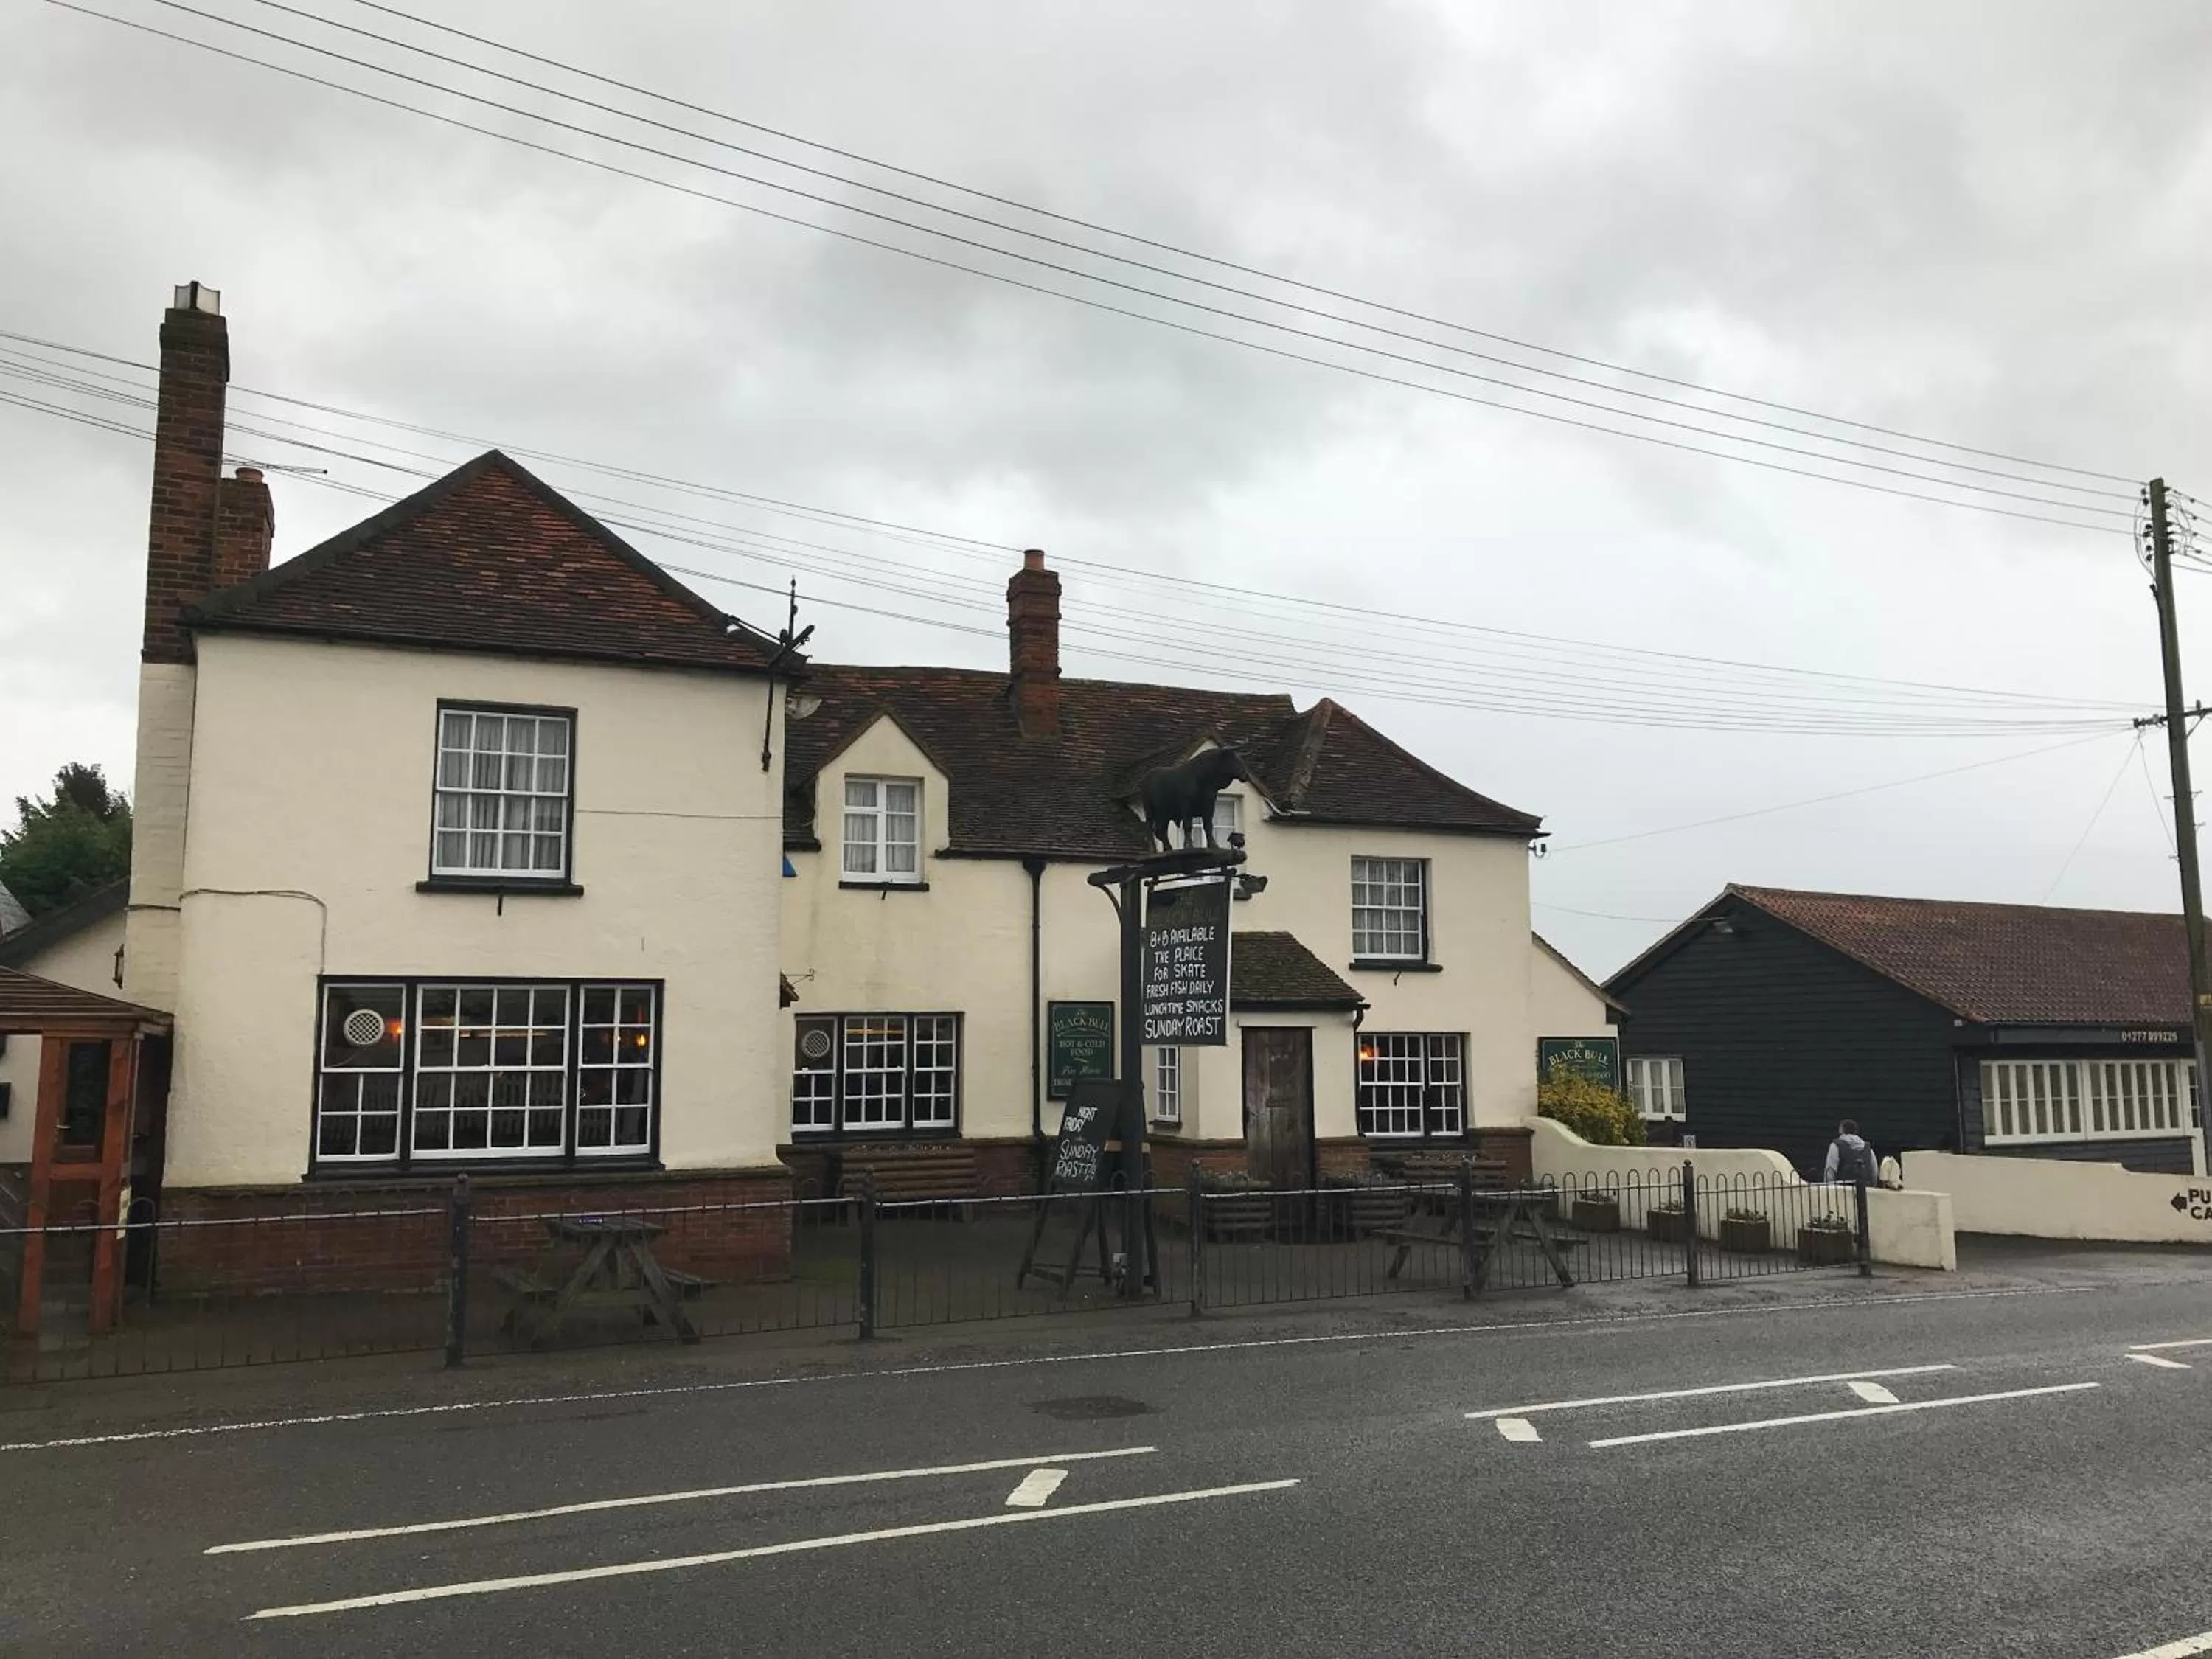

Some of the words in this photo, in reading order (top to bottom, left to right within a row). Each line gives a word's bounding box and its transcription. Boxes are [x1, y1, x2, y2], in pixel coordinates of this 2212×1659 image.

[1173, 946, 1204, 963] PLAICE
[1173, 964, 1206, 978] SKATE
[1147, 983, 1169, 998] FRESH
[1170, 980, 1188, 995] FISH
[1189, 980, 1214, 995] DAILY
[1186, 998, 1224, 1014] SNACKS
[1053, 1018, 1086, 1032] BLACK
[1088, 1018, 1109, 1031] BULL
[1145, 1018, 1185, 1038] SUNDAY
[1185, 1016, 1222, 1036] ROAST
[1548, 1049, 1582, 1066] BLACK
[1585, 1049, 1609, 1065] BULL
[1060, 1138, 1099, 1161] SUNDAY
[2188, 1188, 2211, 1204] PU
